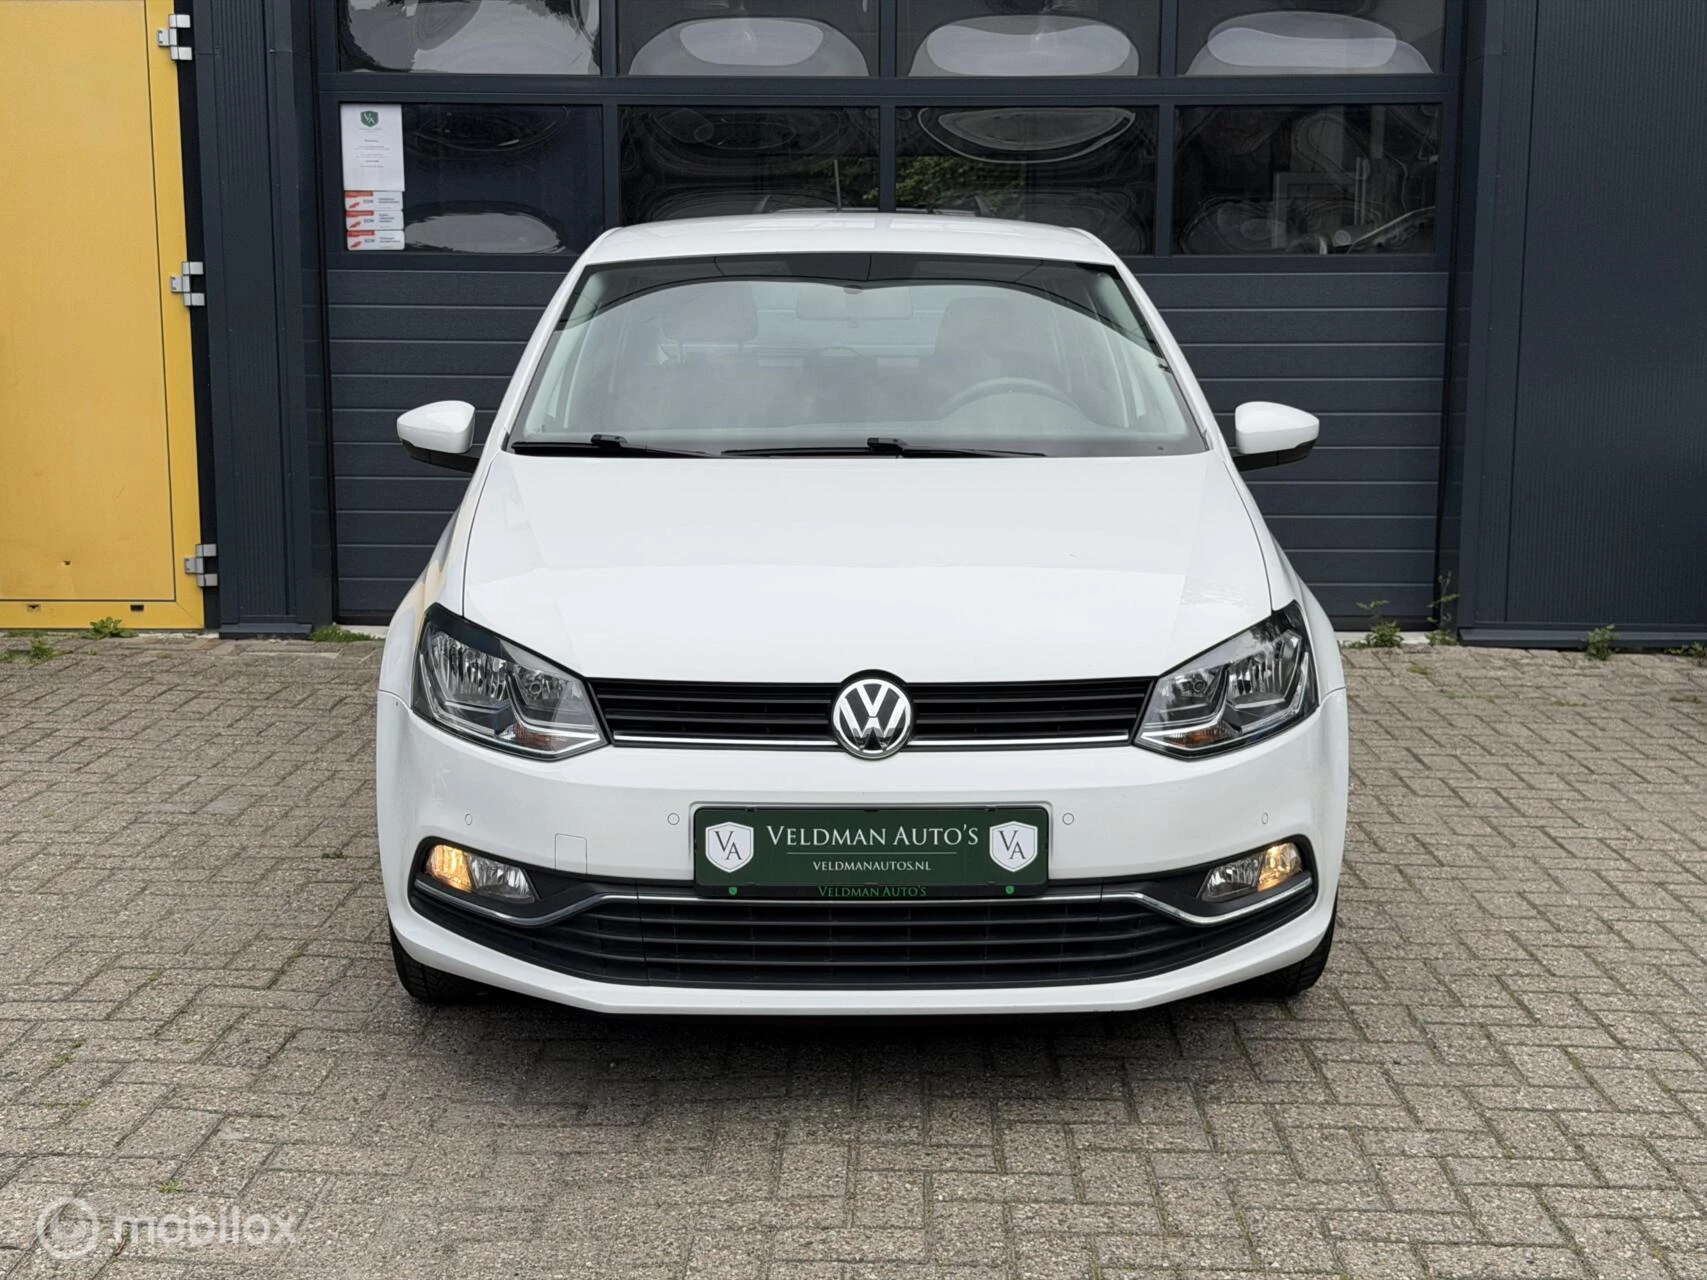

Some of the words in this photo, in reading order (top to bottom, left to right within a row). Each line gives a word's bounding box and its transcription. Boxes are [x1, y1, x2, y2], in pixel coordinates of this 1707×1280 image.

[833, 679, 911, 756] VW
[715, 830, 742, 860] VA
[766, 825, 886, 845] VELDMAN
[892, 824, 979, 845] AUTO'S
[998, 830, 1026, 860] VA
[813, 860, 932, 871] VELDMANAUTOS.NL
[818, 886, 881, 897] VELDMAN
